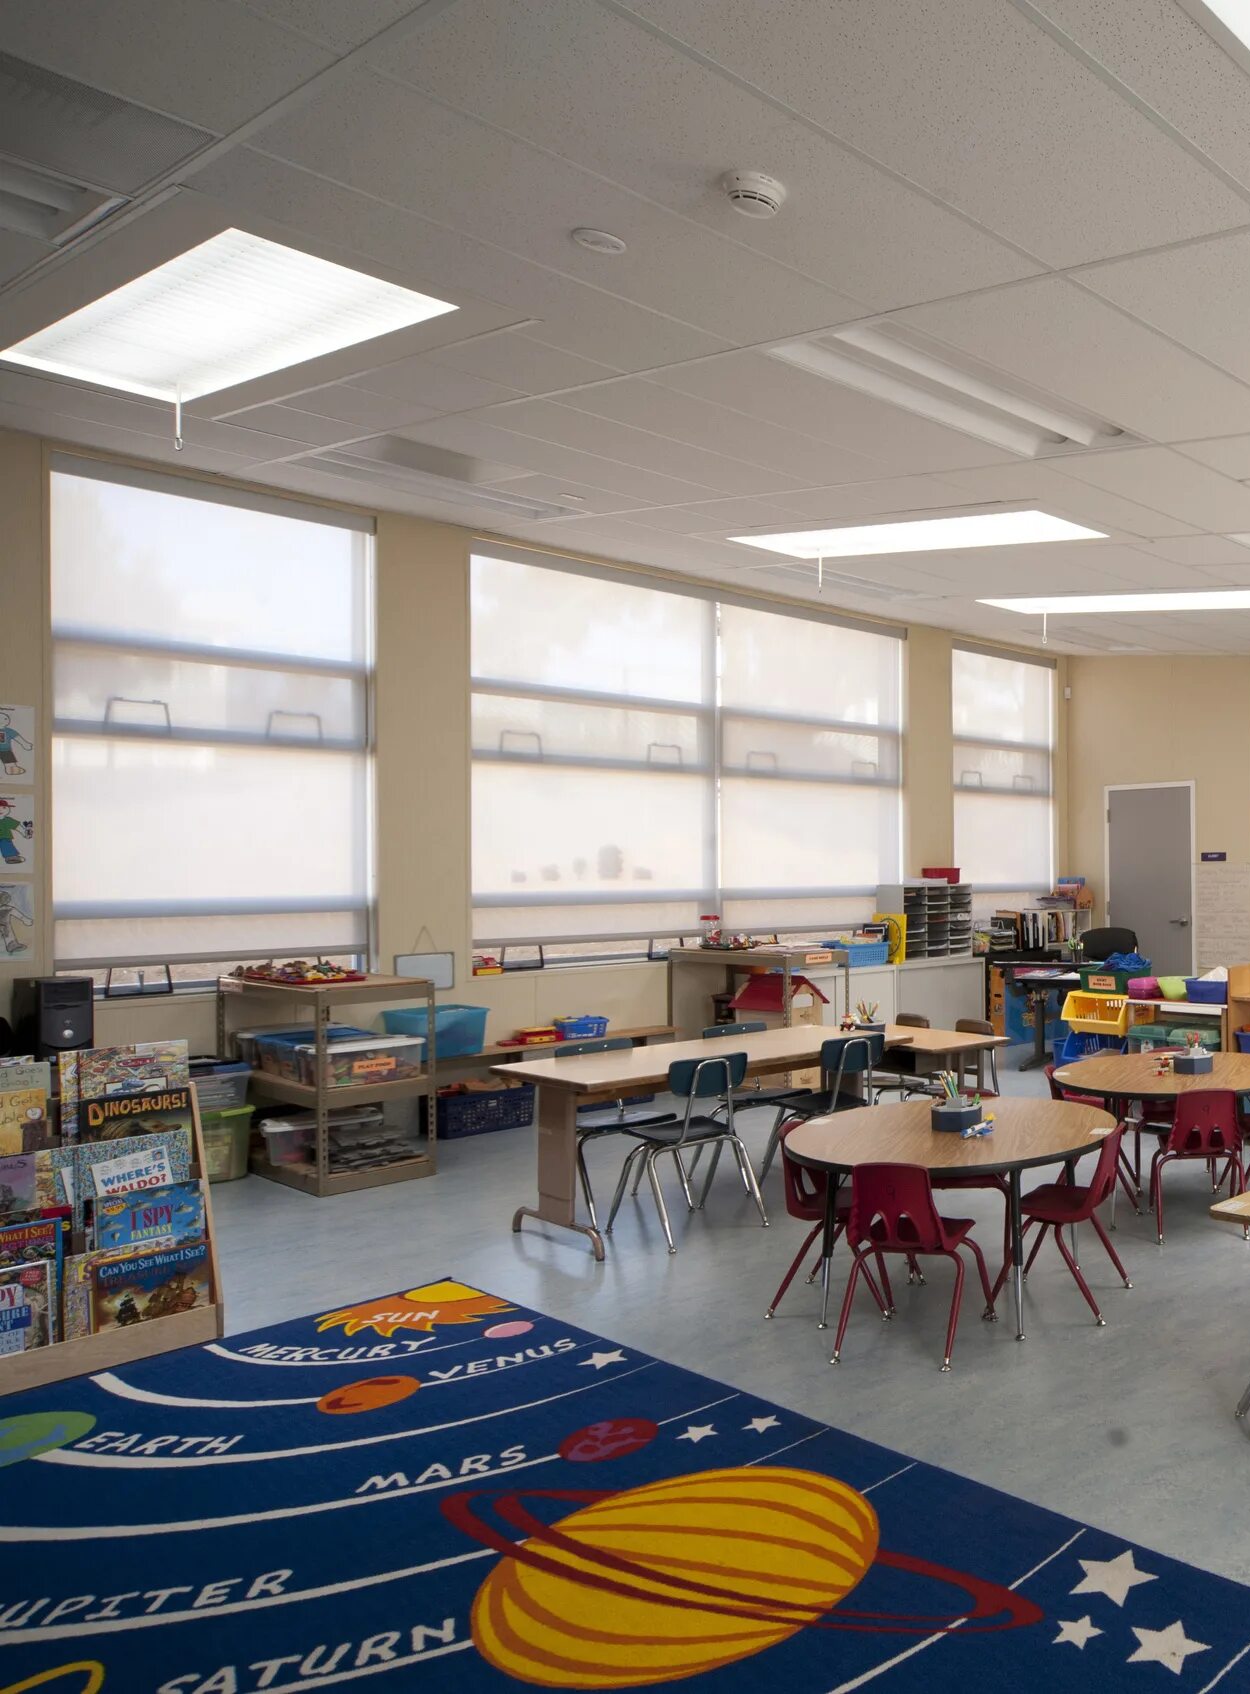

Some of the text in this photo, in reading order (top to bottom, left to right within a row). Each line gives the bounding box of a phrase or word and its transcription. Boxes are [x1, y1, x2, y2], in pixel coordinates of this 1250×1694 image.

[88, 1092, 187, 1126] DINOSAURS!
[101, 1162, 166, 1187] WHERE'S
[131, 1222, 173, 1241] FANTASY
[143, 1204, 173, 1229] SPY
[100, 1265, 119, 1278] CAN
[119, 1260, 138, 1274] YOU
[138, 1257, 155, 1270] SEE
[155, 1253, 179, 1265] WHAT
[184, 1245, 205, 1260] SEE?
[361, 1309, 440, 1326] SUN
[239, 1335, 438, 1362] MERCURY
[428, 1338, 578, 1381] VENUS
[74, 1431, 244, 1455] EARTH
[356, 1445, 528, 1494] MARS
[0, 1568, 293, 1628] UPITER
[157, 1617, 455, 1694] SATURN
